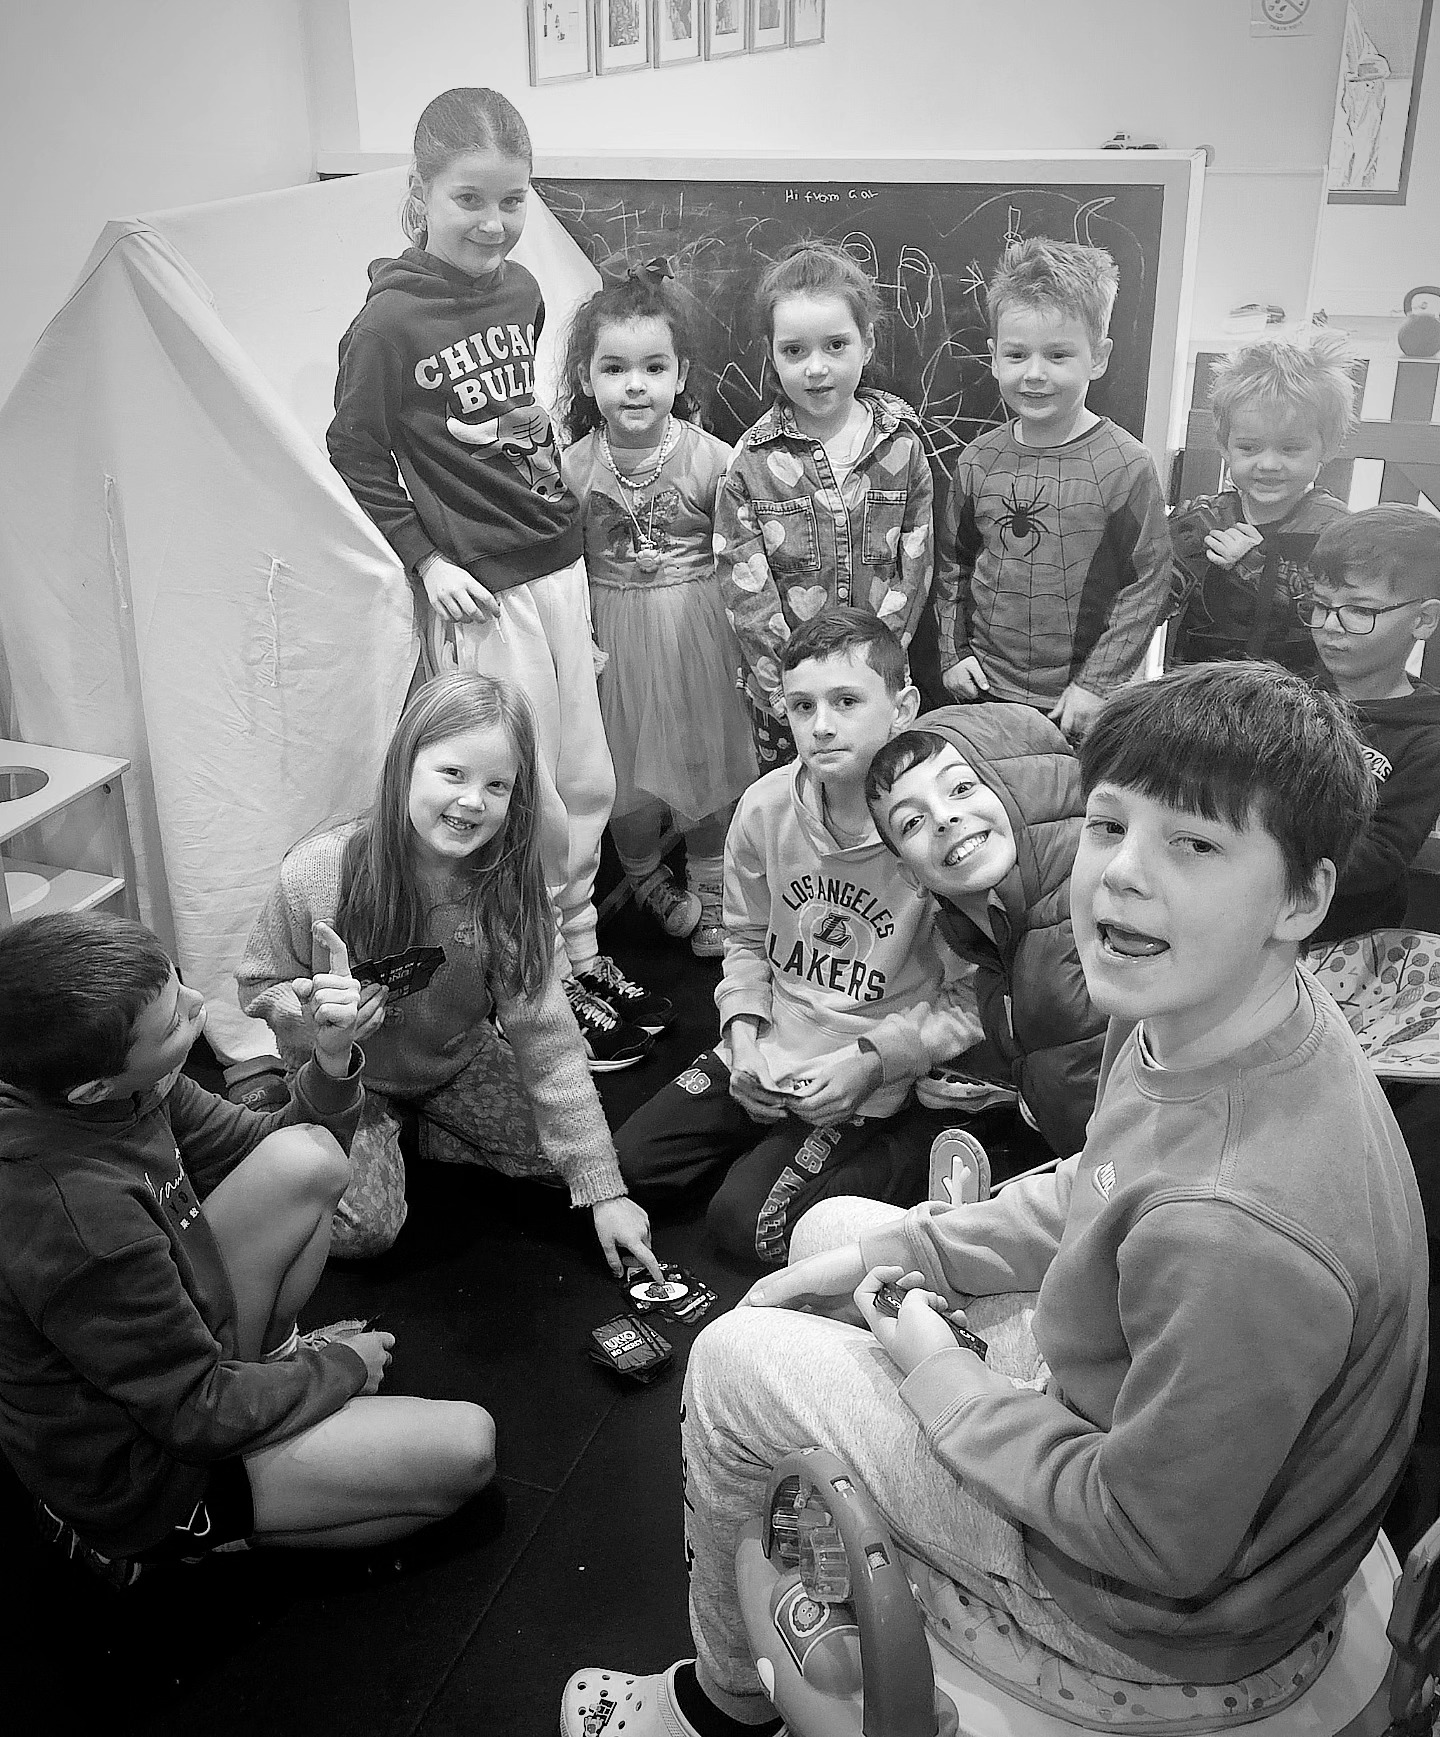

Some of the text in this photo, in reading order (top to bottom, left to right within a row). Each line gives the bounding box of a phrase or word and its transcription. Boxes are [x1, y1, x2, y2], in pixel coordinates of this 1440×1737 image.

[785, 189, 798, 203] Hi
[782, 875, 895, 939] LOS ANGELES
[768, 932, 886, 1002] LAKERS
[603, 1330, 637, 1351] UNO
